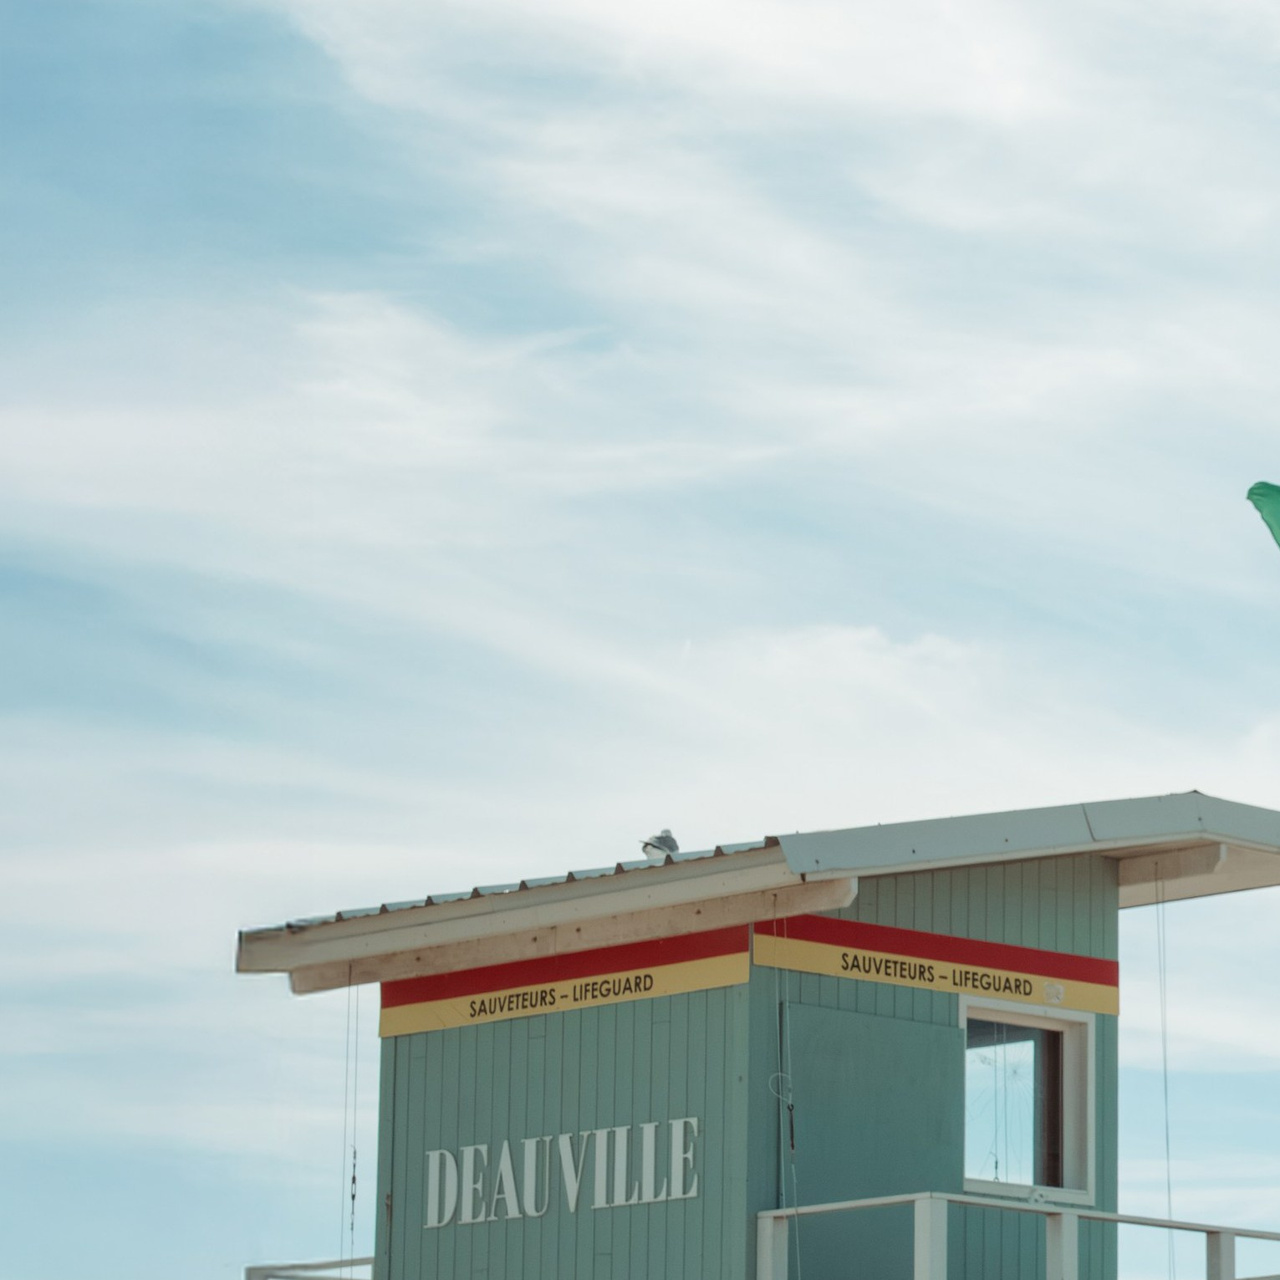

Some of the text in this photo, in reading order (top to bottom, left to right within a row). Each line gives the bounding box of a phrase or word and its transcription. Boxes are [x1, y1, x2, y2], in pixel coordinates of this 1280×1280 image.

[469, 988, 556, 1017] SAUVETEURS
[573, 974, 653, 1002] LIFEGUARD
[841, 952, 935, 983] SAUVETEURS
[952, 969, 1033, 996] LIFEGUARD
[423, 1116, 699, 1229] DEAUVILLE
